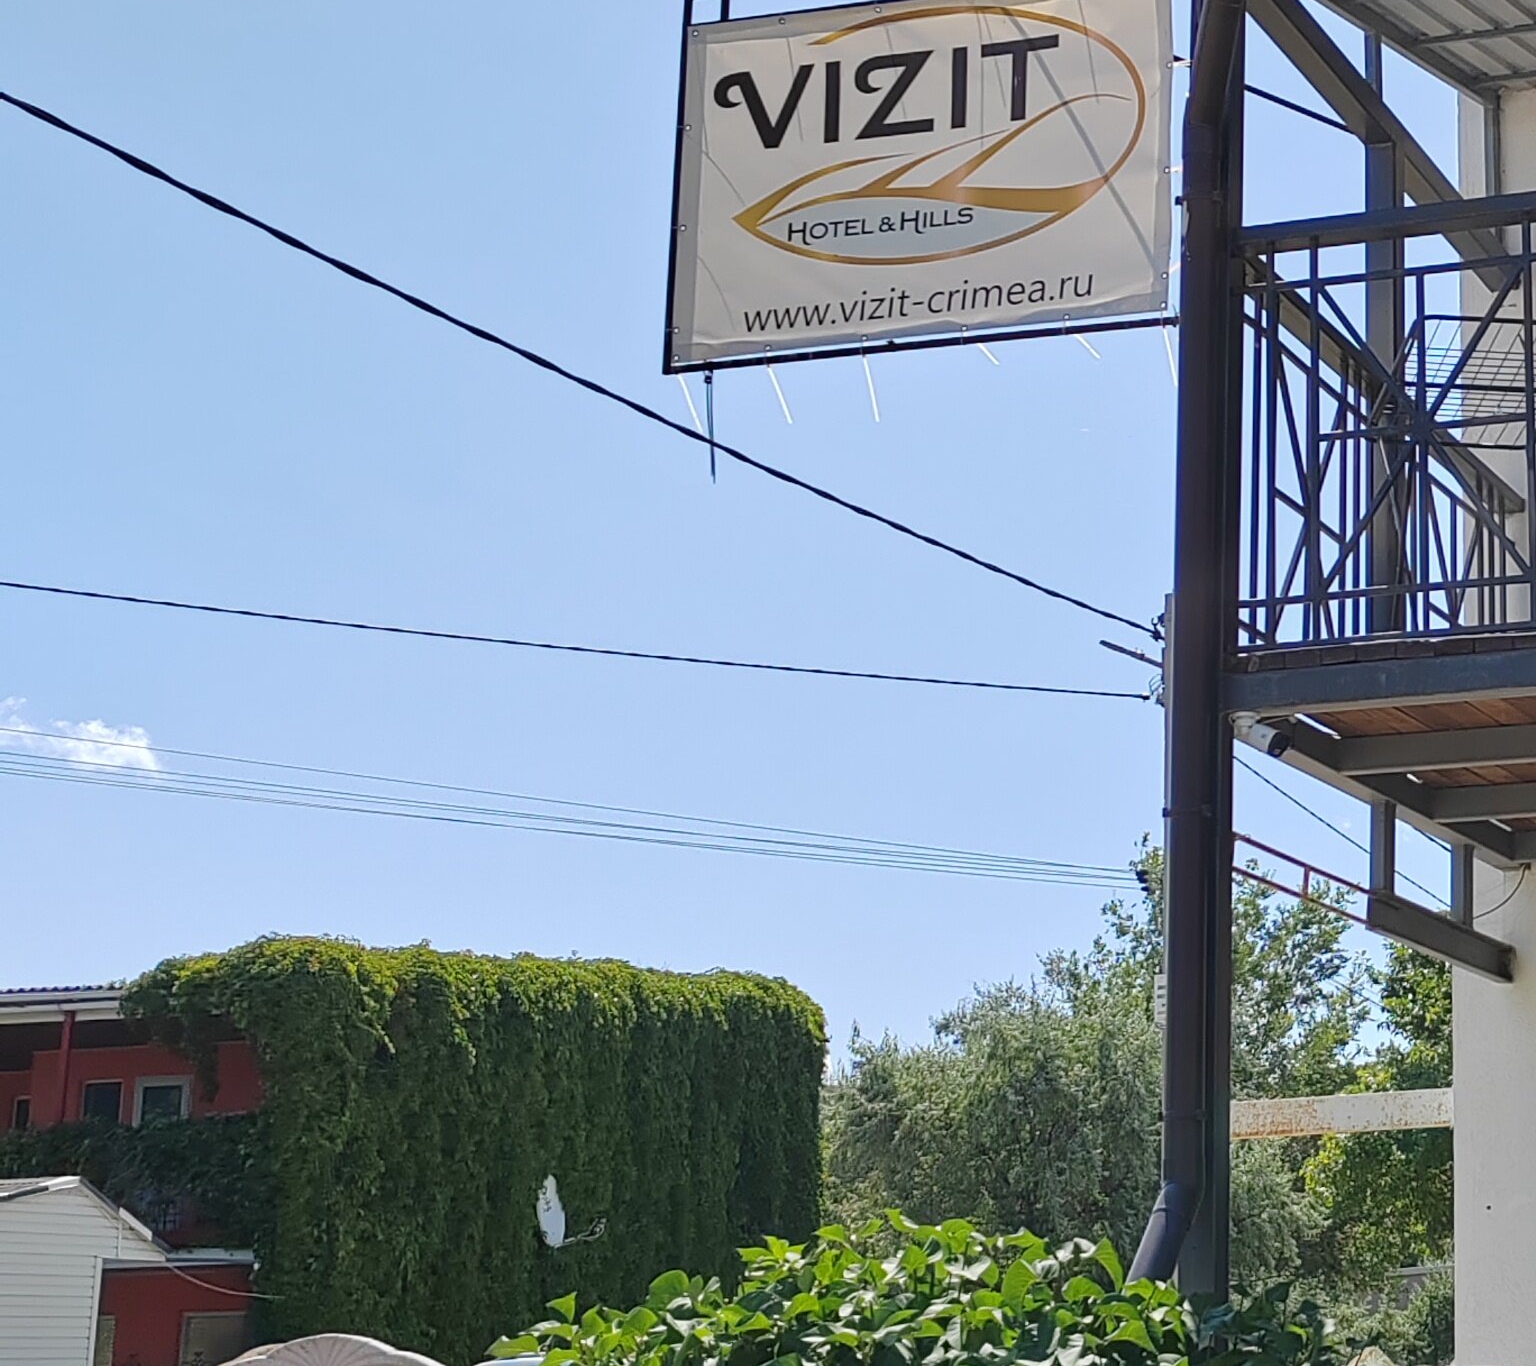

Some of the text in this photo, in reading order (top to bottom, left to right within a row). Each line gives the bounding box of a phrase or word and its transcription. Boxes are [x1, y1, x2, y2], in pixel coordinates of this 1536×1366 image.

[713, 34, 1059, 149] VIZIT
[878, 216, 896, 233] &
[743, 273, 1094, 333] www.vizit-crimea.ru
